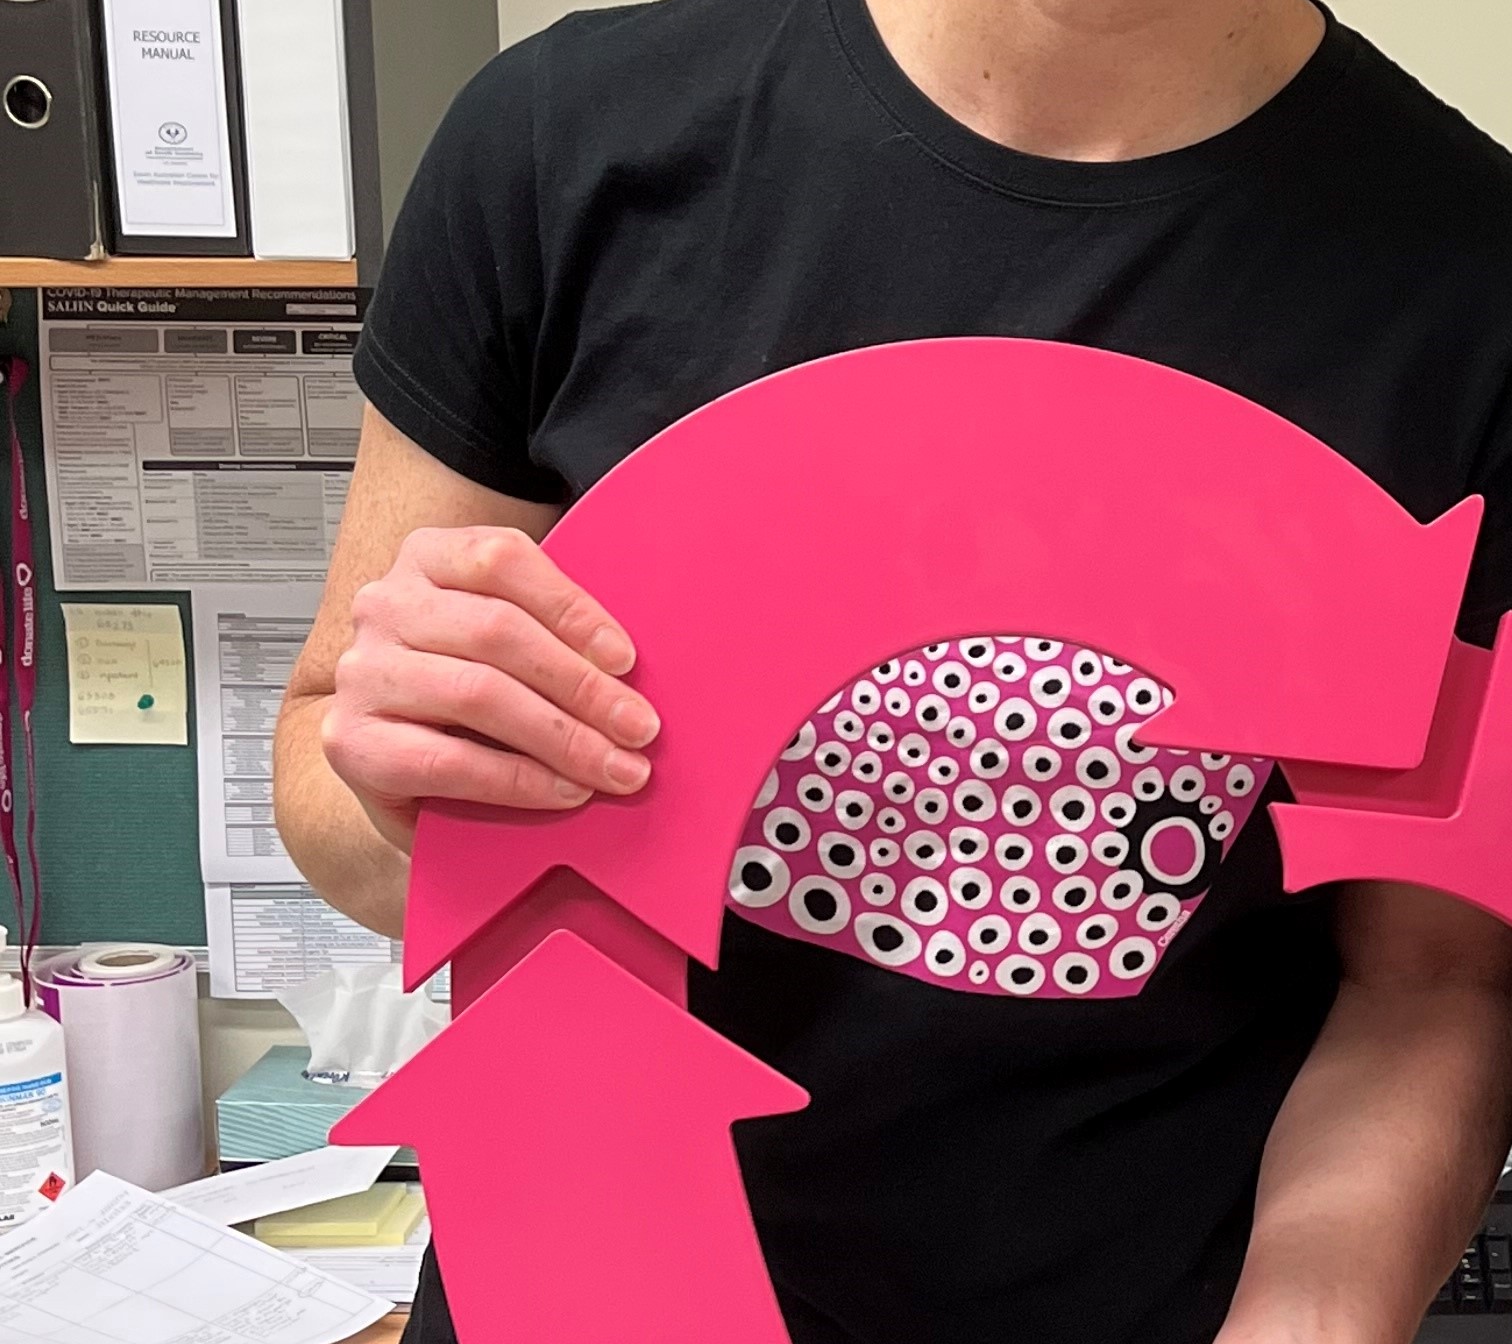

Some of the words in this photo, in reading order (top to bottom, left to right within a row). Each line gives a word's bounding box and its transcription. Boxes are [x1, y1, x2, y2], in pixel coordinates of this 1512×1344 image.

[133, 30, 200, 44] RESOURCE
[141, 47, 195, 60] MANUAL
[47, 287, 102, 298] COVID-19
[106, 287, 172, 300] Therapeutic
[175, 288, 249, 301] Management
[252, 289, 356, 301] Recommendations
[97, 301, 135, 313] Quick
[137, 301, 177, 313] Guide
[21, 615, 34, 667] donate
